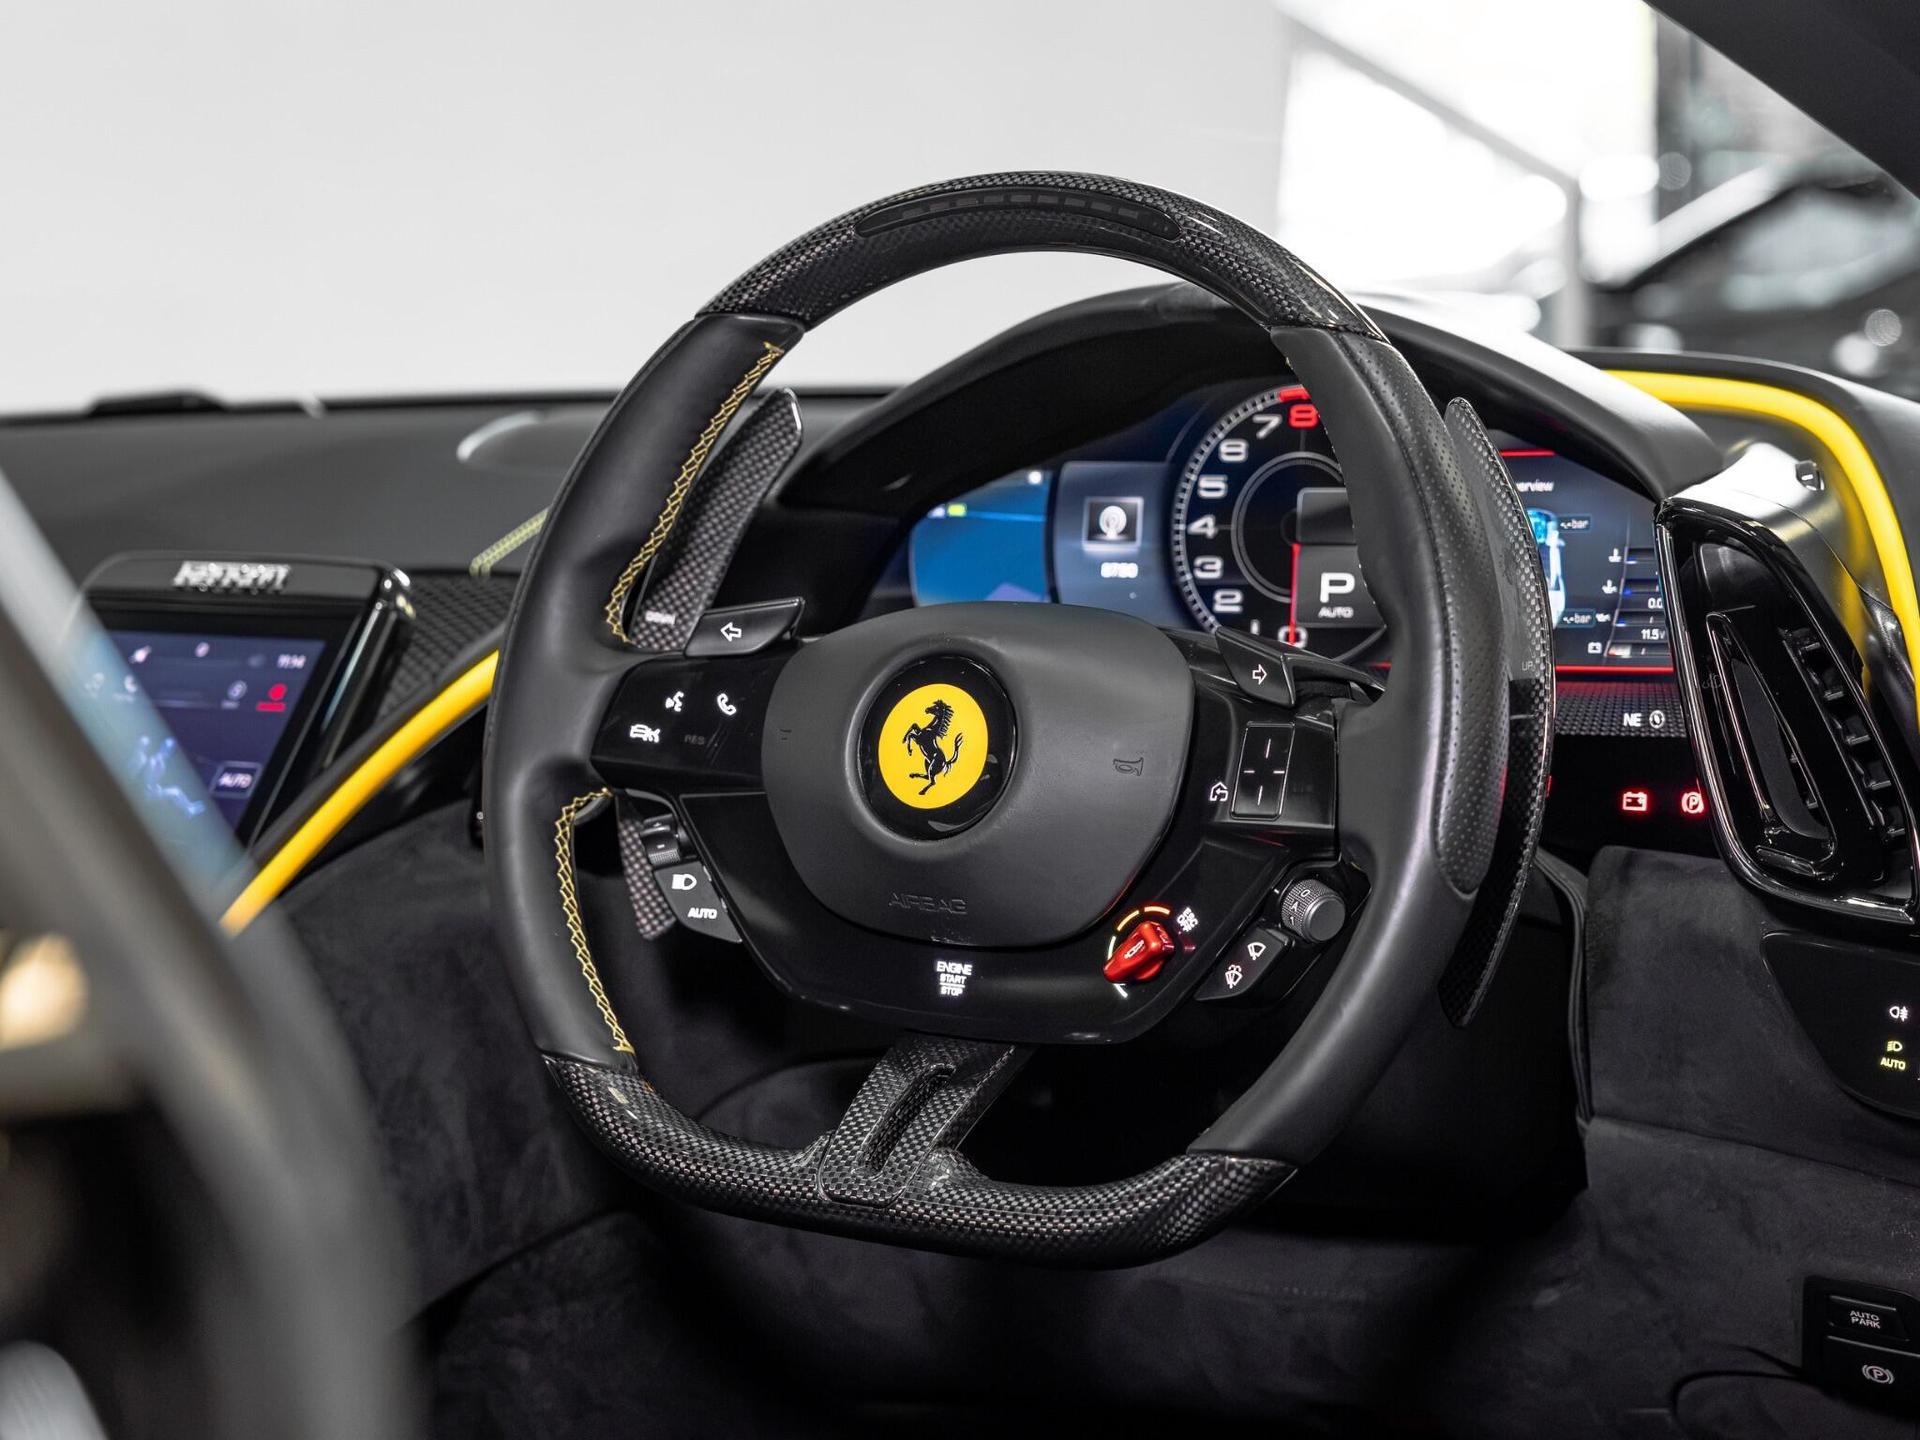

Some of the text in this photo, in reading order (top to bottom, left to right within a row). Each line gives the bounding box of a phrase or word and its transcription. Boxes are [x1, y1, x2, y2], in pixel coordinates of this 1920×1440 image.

[1289, 404, 1319, 428] 8
[1252, 414, 1281, 439] 7
[1198, 474, 1228, 499] 5
[1187, 514, 1217, 539] 4
[1193, 556, 1223, 579] 3
[1320, 572, 1355, 603] P
[1213, 589, 1243, 613] 2
[1318, 607, 1354, 618] AUTO
[1623, 712, 1642, 727] NE
[687, 907, 718, 920] AUTO
[936, 960, 973, 976] ENGINE
[939, 973, 968, 985] START
[940, 985, 964, 997] STOP
[1880, 1057, 1906, 1070] AUTO
[1849, 1310, 1881, 1321] AUTO
[1851, 1316, 1881, 1329] PARK
